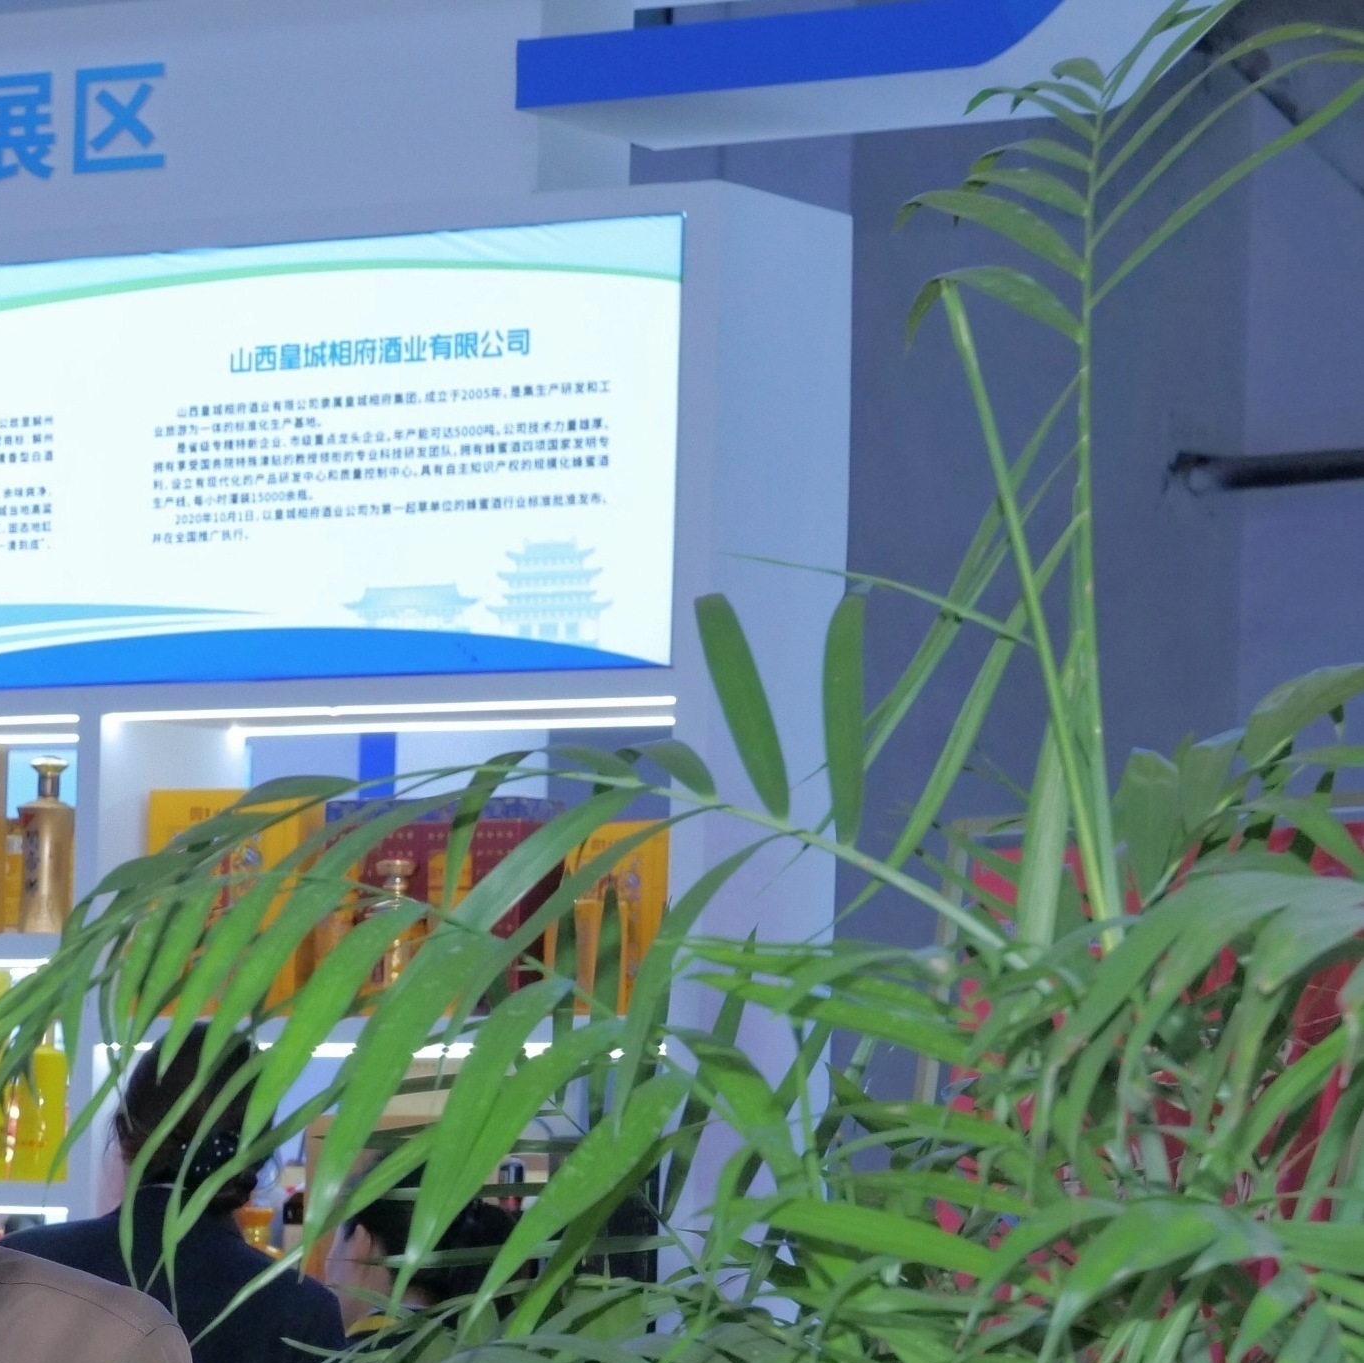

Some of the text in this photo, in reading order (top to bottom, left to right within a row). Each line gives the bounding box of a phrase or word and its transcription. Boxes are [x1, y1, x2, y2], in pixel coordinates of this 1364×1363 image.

[229, 327, 531, 375] 山西皇城相府酒业有限公司
